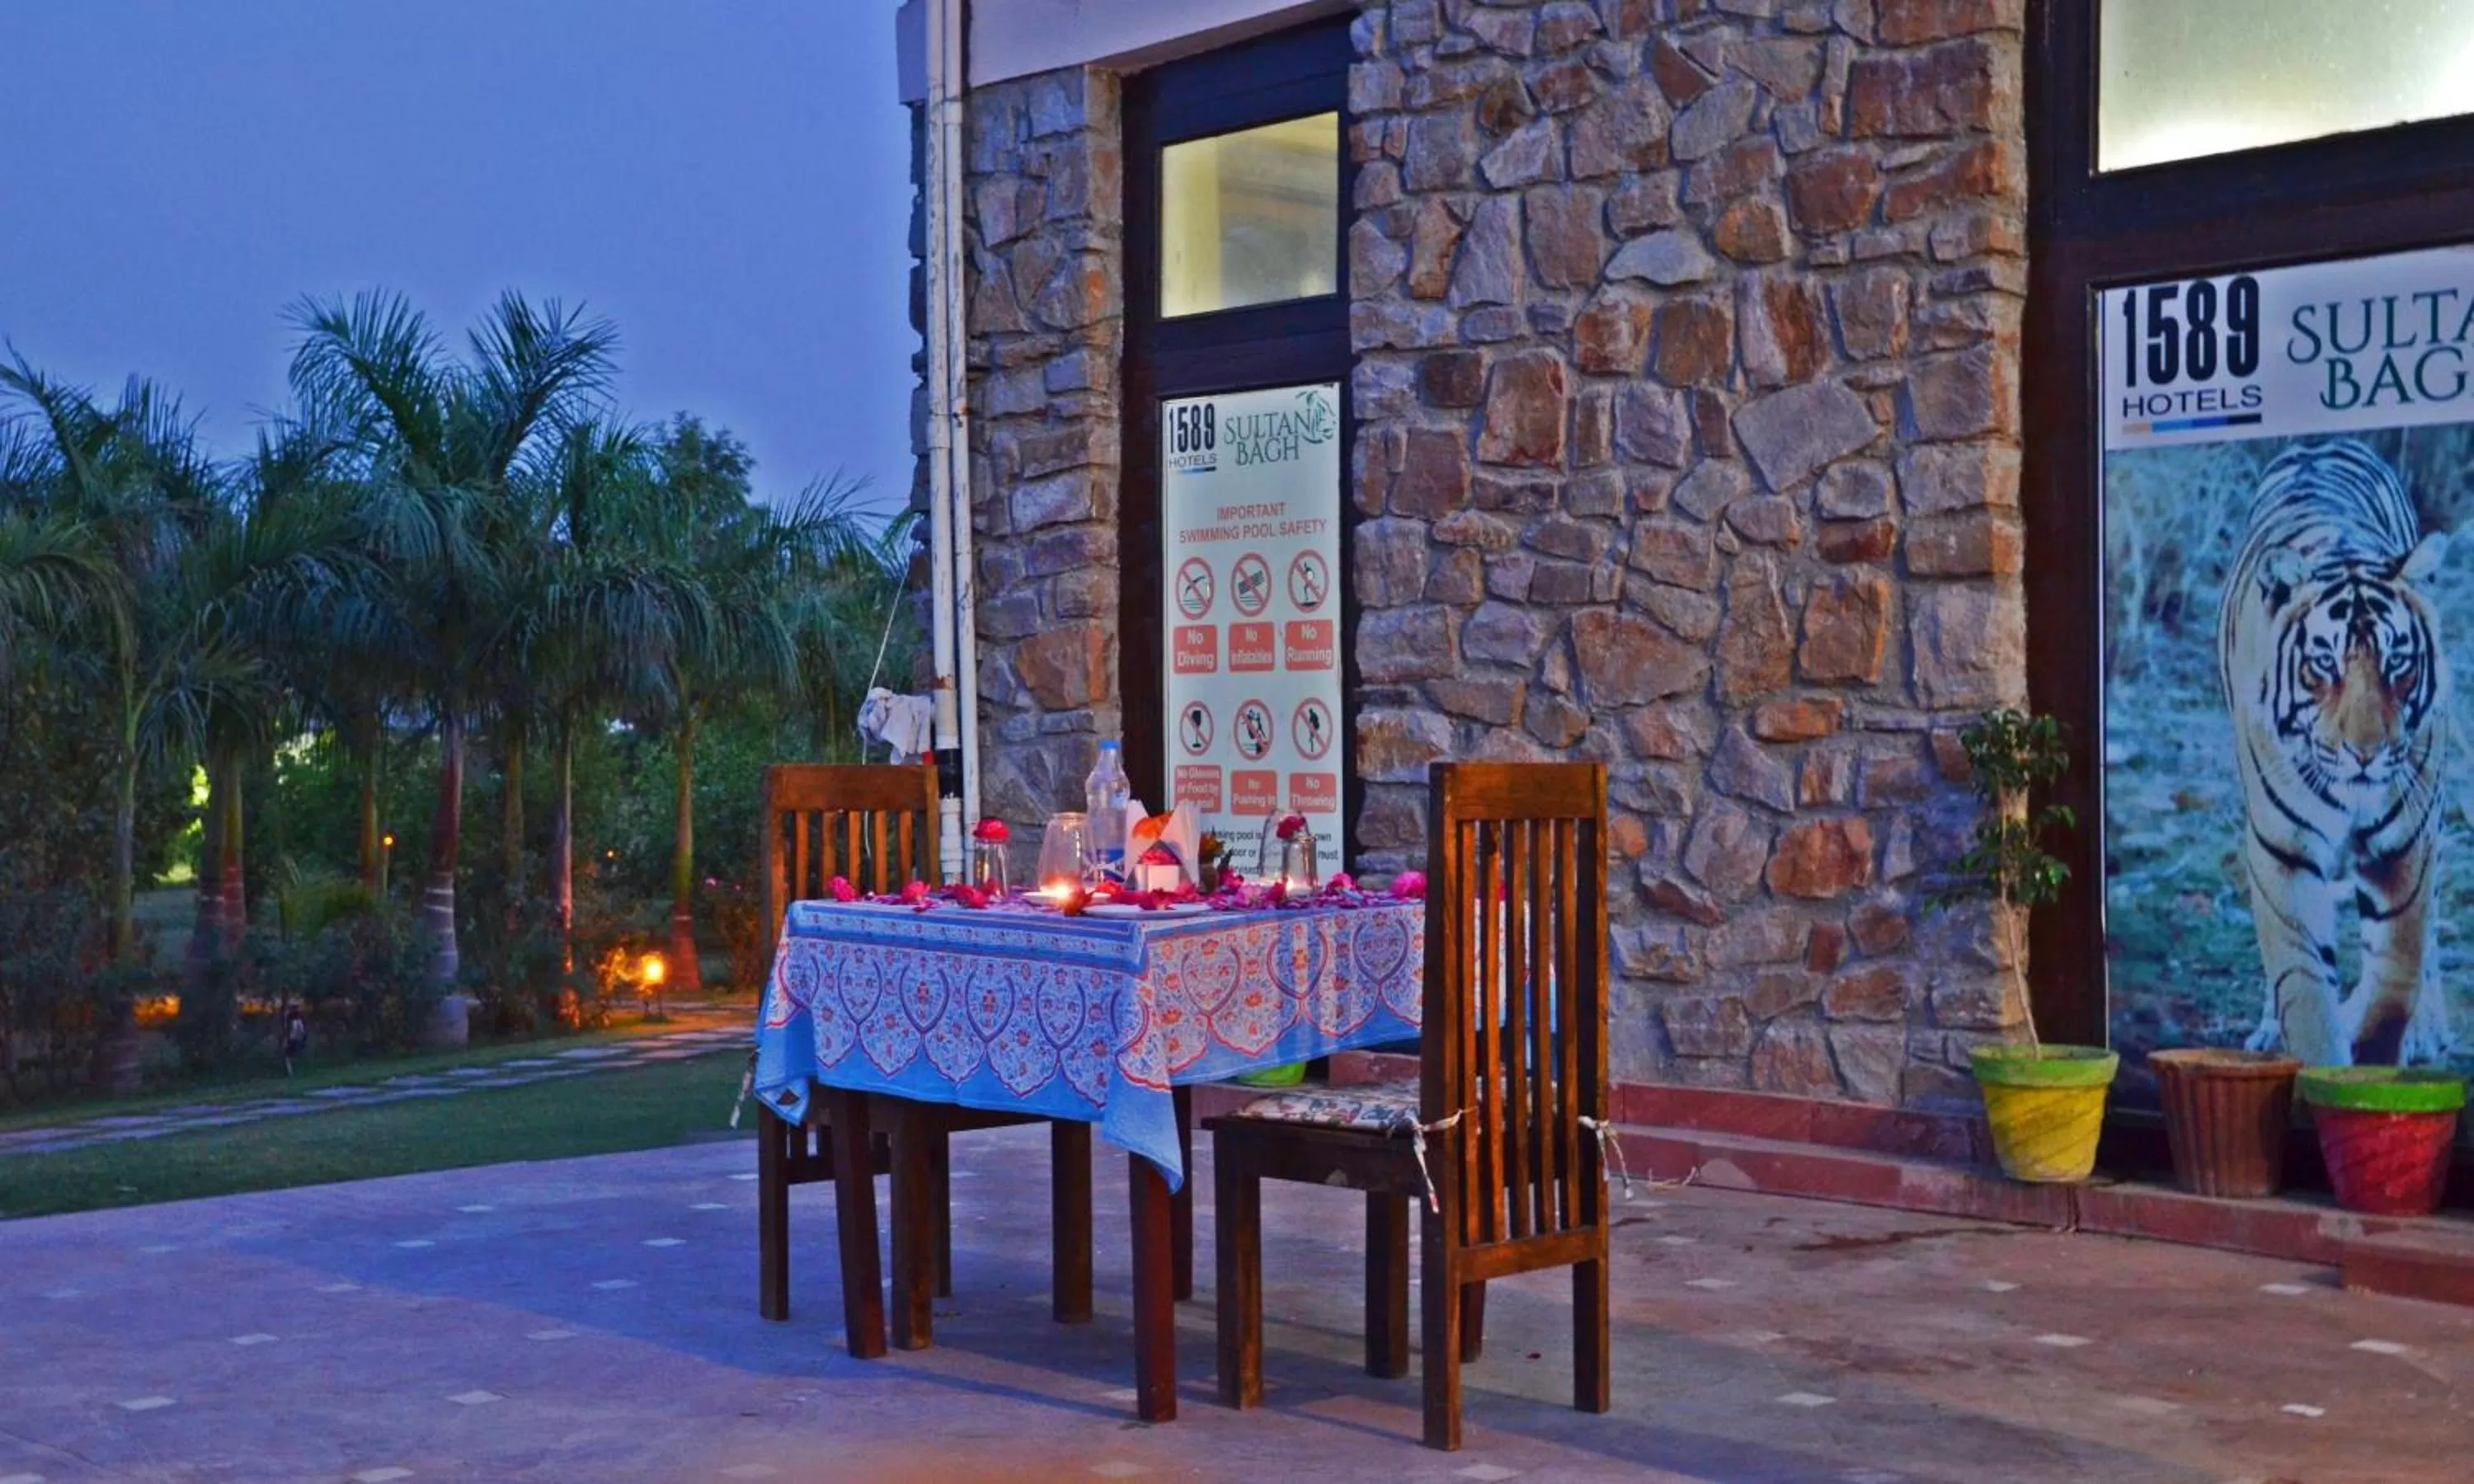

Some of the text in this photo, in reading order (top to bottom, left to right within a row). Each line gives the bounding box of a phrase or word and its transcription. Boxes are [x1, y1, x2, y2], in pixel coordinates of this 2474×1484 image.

[2122, 275, 2260, 388] 1589
[2319, 345, 2474, 410] BAG
[2122, 384, 2263, 418] HOTELS
[1169, 402, 1216, 454] 1589
[1223, 408, 1312, 445] SULTAN
[1235, 434, 1300, 466] BAGH
[1169, 453, 1218, 469] HOTELS
[1216, 501, 1287, 522] IMPORTANT
[1179, 518, 1327, 544] SWIMMING POOL SAFETY
[1187, 630, 1204, 646] No
[1245, 627, 1258, 642] No
[1300, 623, 1318, 641] No
[1177, 649, 1216, 669] Diving
[1286, 645, 1333, 666] Running
[1305, 775, 1320, 790] No
[1236, 830, 1254, 842] pool
